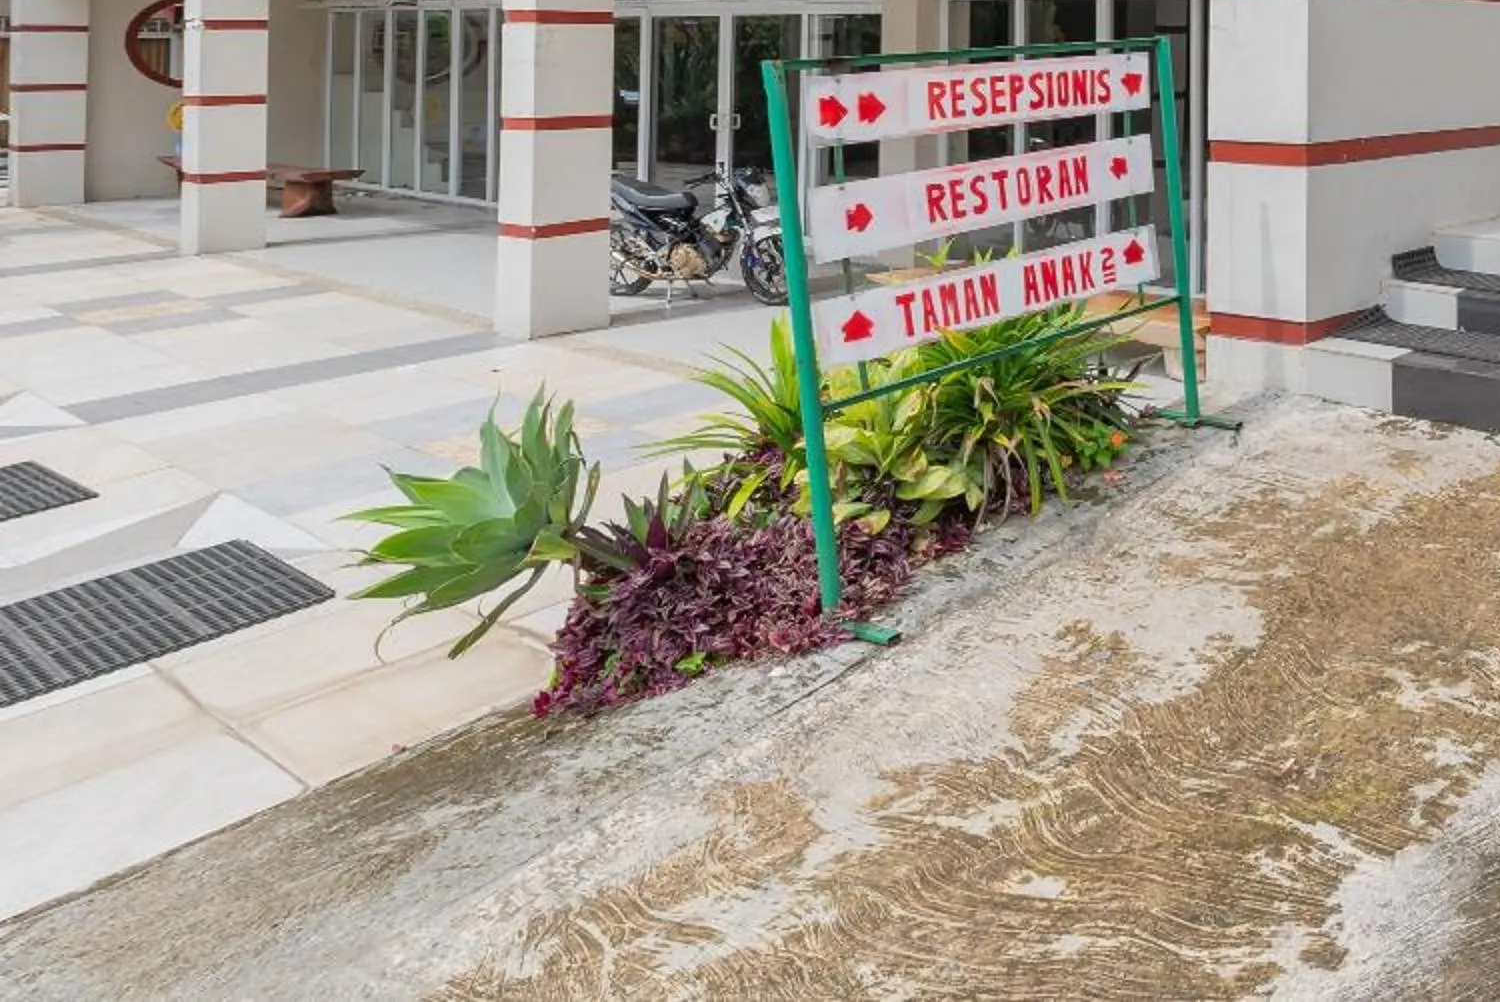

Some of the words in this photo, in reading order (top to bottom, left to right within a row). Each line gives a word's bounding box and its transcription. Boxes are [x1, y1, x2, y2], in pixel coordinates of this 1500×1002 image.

[927, 69, 1112, 120] RESEPSIONIS
[925, 156, 1089, 223] RESTORAN
[896, 273, 1000, 337] TAMAN
